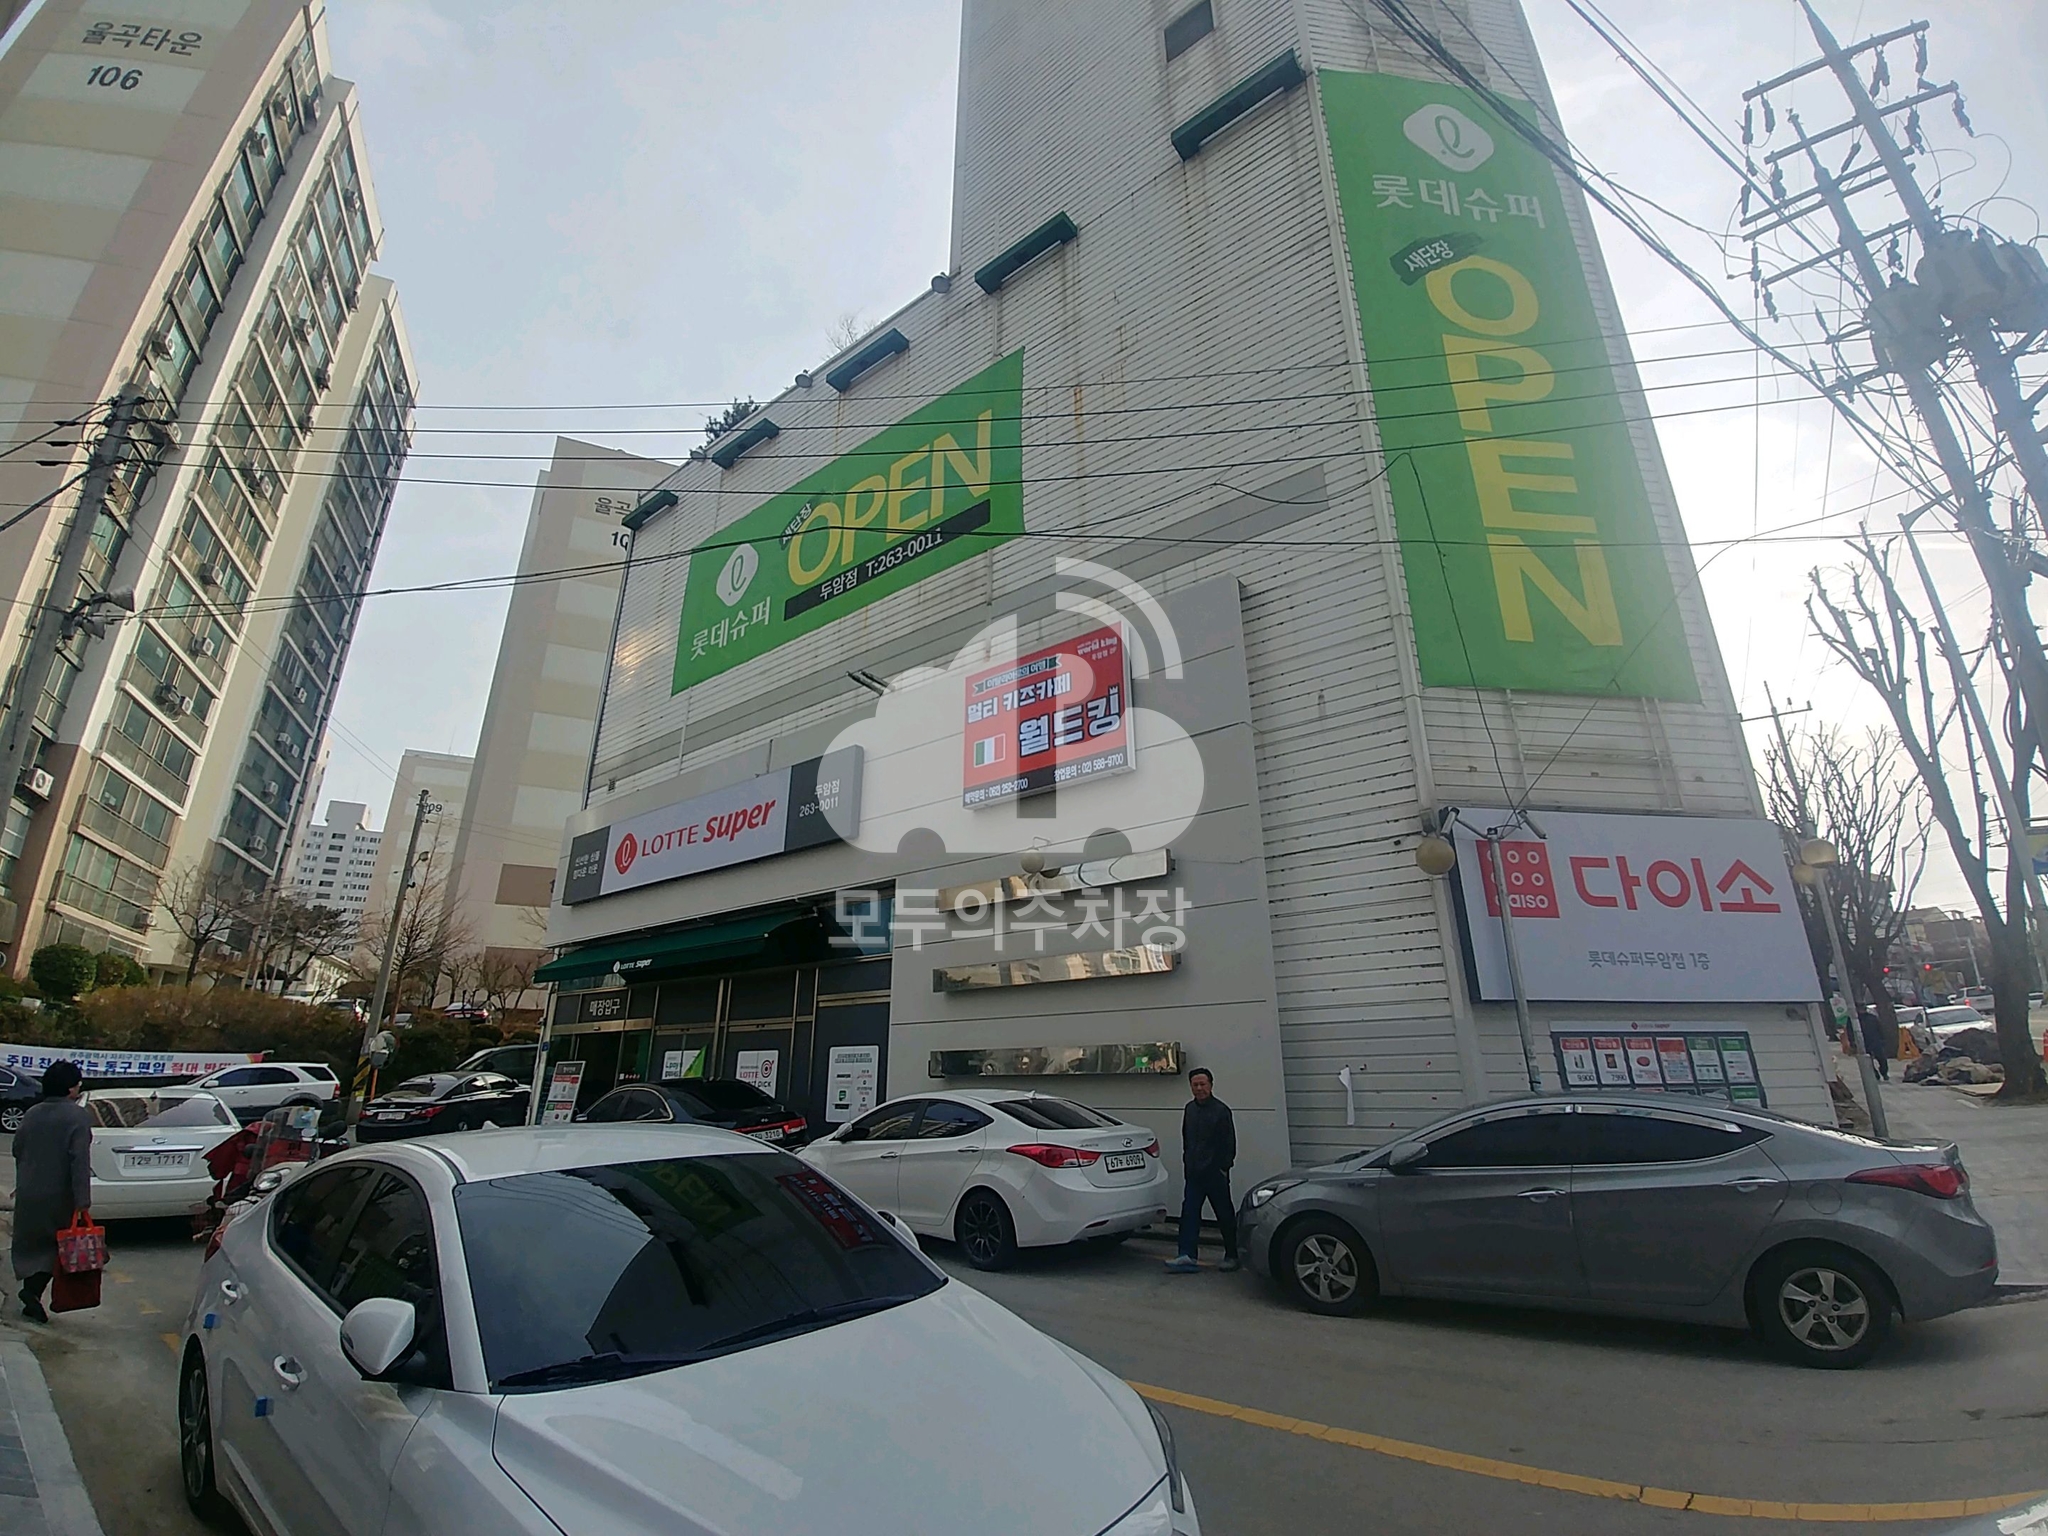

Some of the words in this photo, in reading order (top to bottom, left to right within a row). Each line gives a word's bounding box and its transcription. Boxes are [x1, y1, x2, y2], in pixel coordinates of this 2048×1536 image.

[81, 21, 203, 56] 율곡타운
[87, 65, 143, 90] 106
[1372, 174, 1546, 229] 롯데슈퍼
[1404, 240, 1454, 272] 새단장
[1425, 254, 1624, 647] OPEN
[787, 409, 993, 586] OPEN
[782, 503, 812, 545] 새단장
[820, 567, 858, 600] 두암점
[865, 527, 943, 577] T:263-0011
[690, 596, 771, 662] 롯데슈퍼
[967, 696, 998, 724] 멀티
[1003, 672, 1071, 711] 키즈카페
[1019, 685, 1121, 757] 월드킹
[814, 779, 840, 798] 두암점
[799, 796, 839, 818] 263-0011
[641, 824, 699, 857] LOTTE
[1495, 894, 1549, 909] aiso
[1569, 855, 1782, 914] 다이소
[1588, 951, 1686, 970] 롯데슈퍼두암점
[1689, 952, 1710, 970] 1층
[589, 998, 621, 1016] 매장입구
[7, 1054, 33, 1069] 주민
[104, 1060, 132, 1073] 동구
[138, 1062, 166, 1074] 편입
[171, 1062, 198, 1073] 절대
[157, 1155, 184, 1165] 1712
